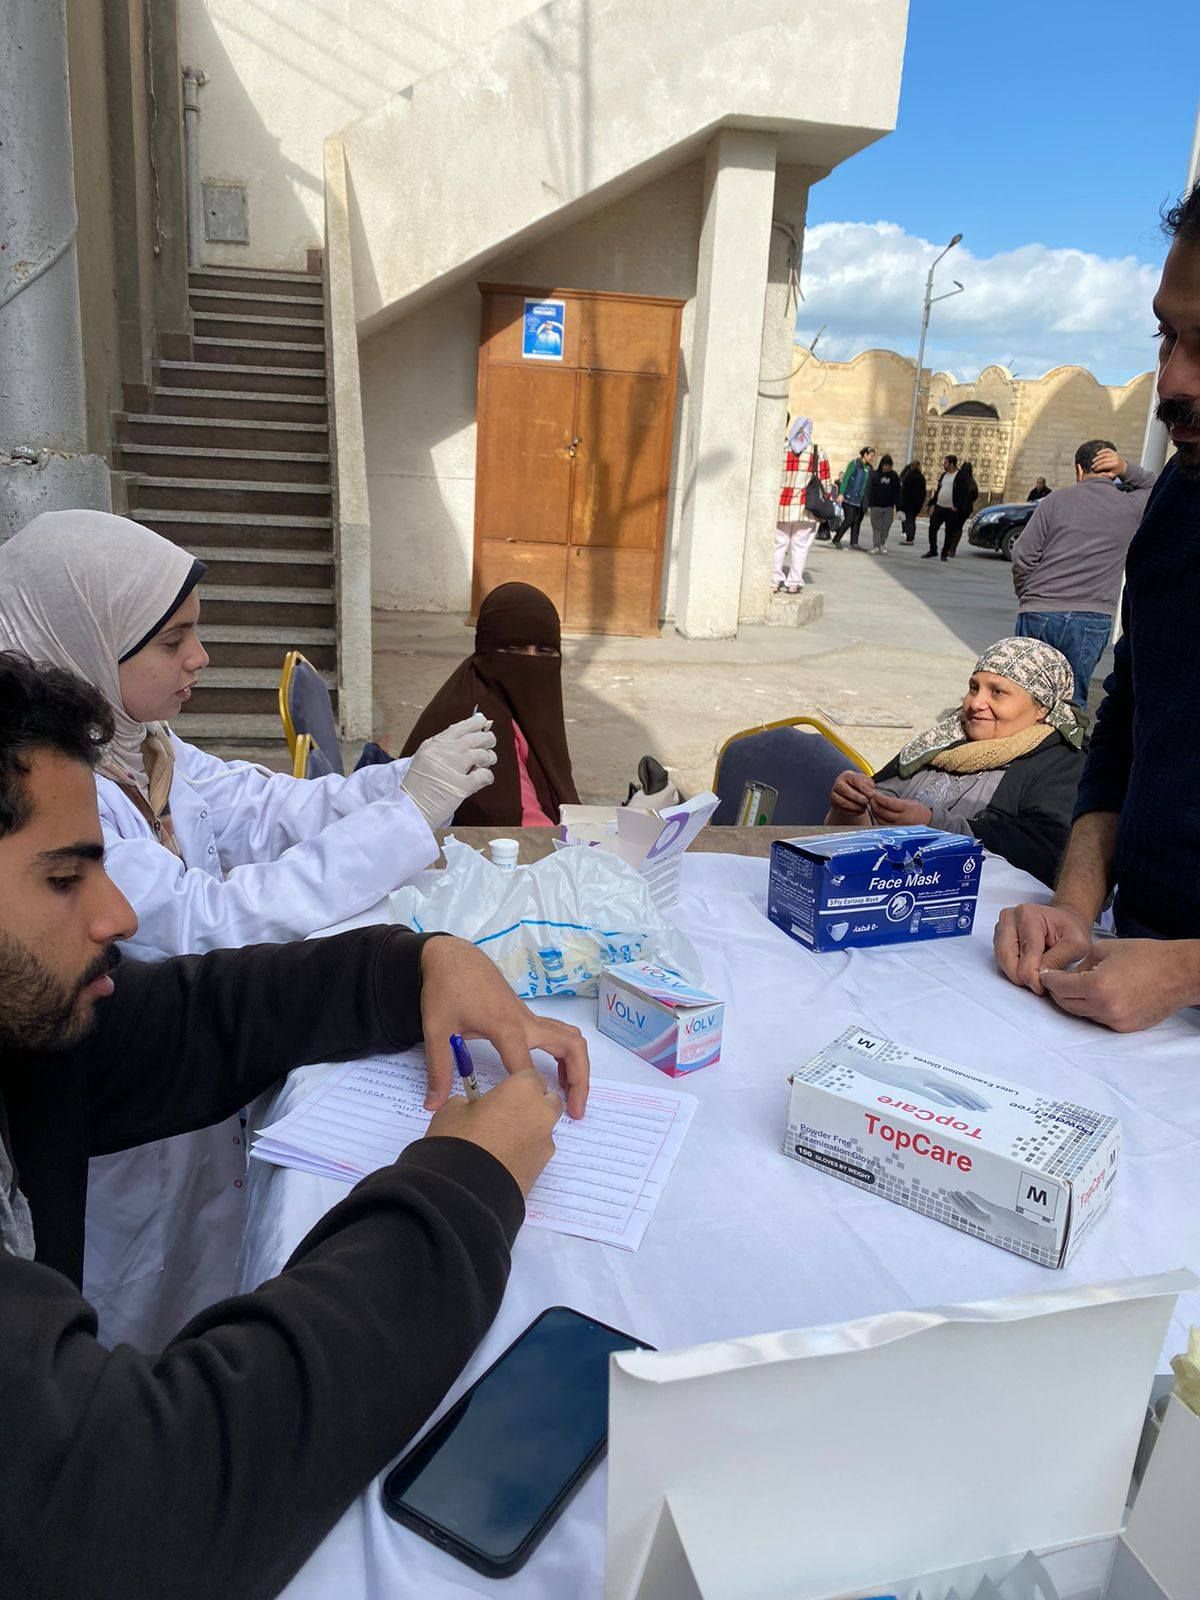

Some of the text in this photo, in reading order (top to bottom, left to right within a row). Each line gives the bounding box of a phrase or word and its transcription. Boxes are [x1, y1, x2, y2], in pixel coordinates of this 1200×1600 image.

[869, 871, 941, 890] Face Mask
[641, 966, 688, 988] VOLV
[607, 993, 645, 1029] VOLV
[686, 1014, 715, 1034] VOLV
[913, 1056, 1019, 1095] Latex Examination Gloves
[877, 1095, 982, 1140] TopCare
[1009, 1102, 1039, 1115] Free
[800, 1123, 852, 1148] Powder Free
[1041, 1111, 1094, 1136] Powder
[799, 1132, 881, 1169] Examination Gloves
[864, 1113, 973, 1172] TopCare
[798, 1147, 871, 1180] 100 GLOVES BY WEIGHT
[1026, 1185, 1047, 1206] M
